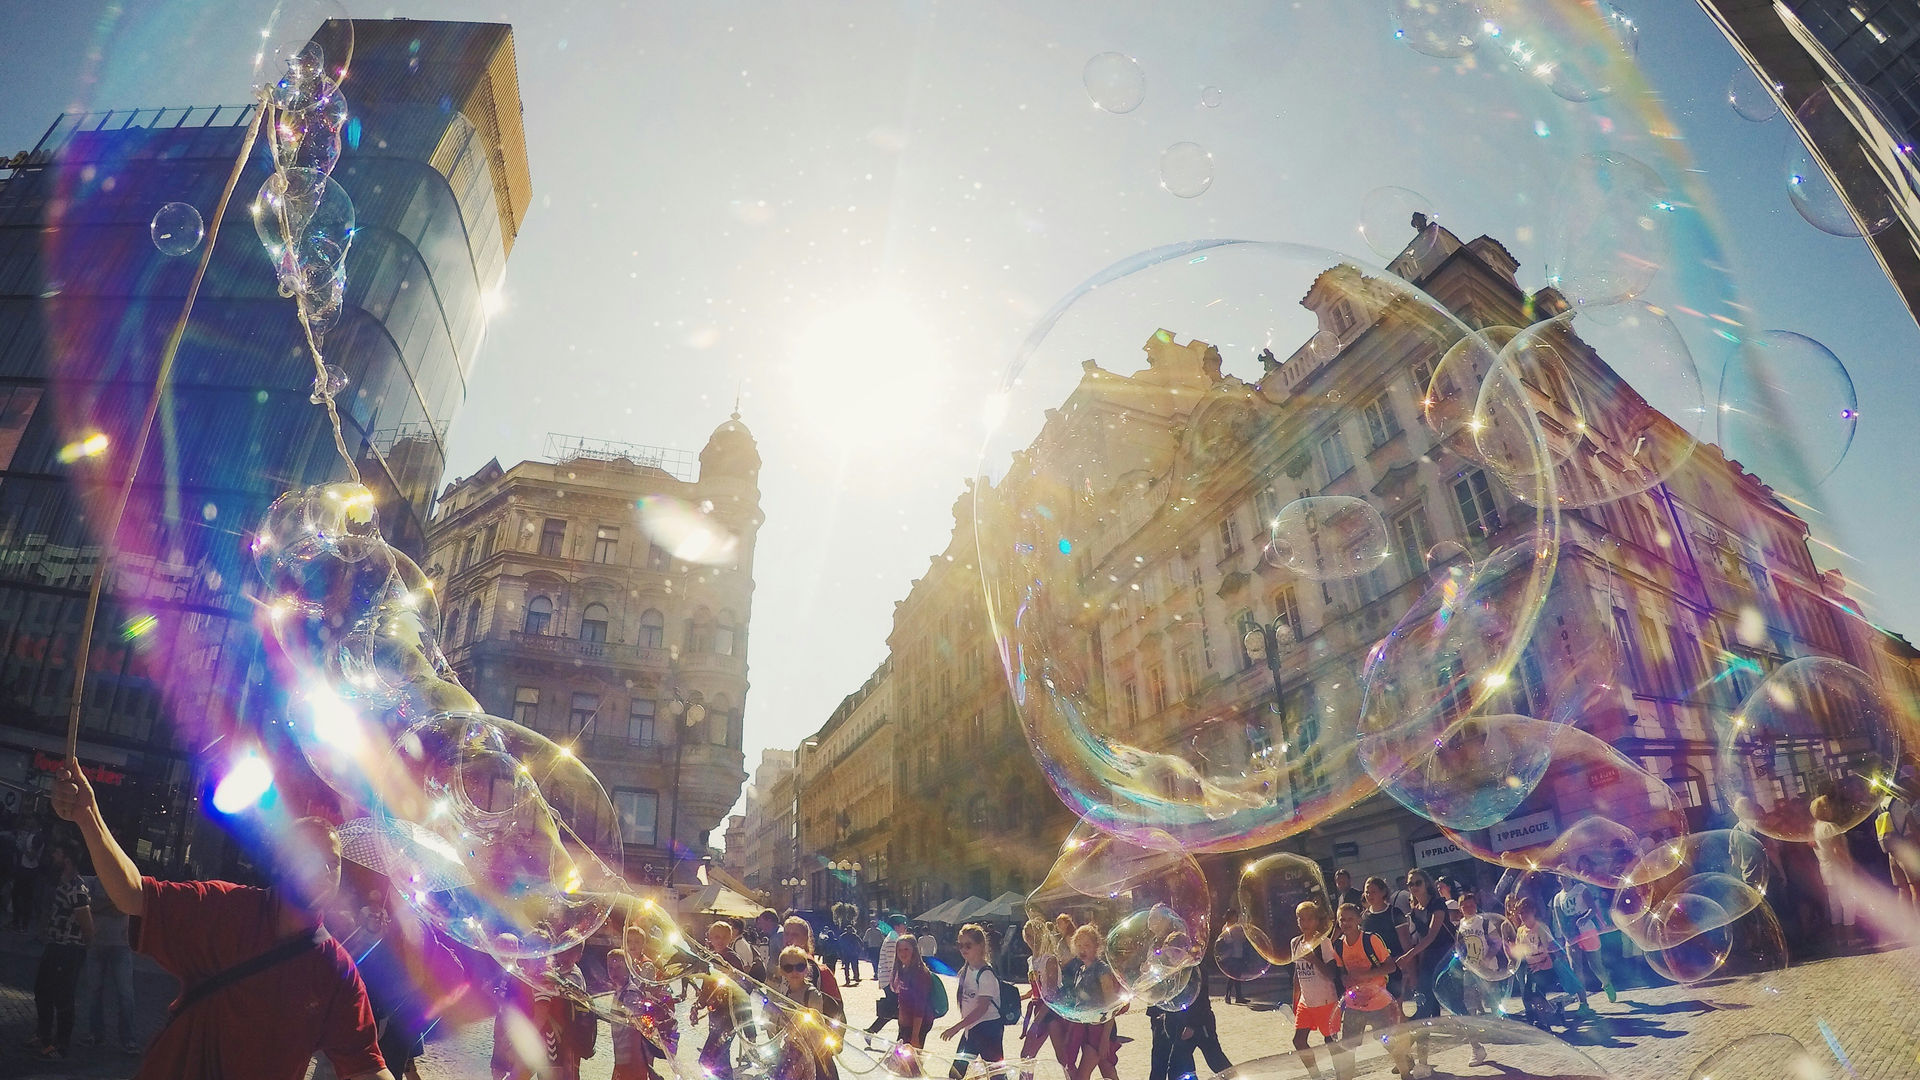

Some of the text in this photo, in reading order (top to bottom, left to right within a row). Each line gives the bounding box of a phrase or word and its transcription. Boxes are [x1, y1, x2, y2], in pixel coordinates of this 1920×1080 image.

[1191, 566, 1213, 670] HOTEL
[1511, 822, 1549, 838] PRAGUE
[1432, 844, 1460, 854] PRAGU
